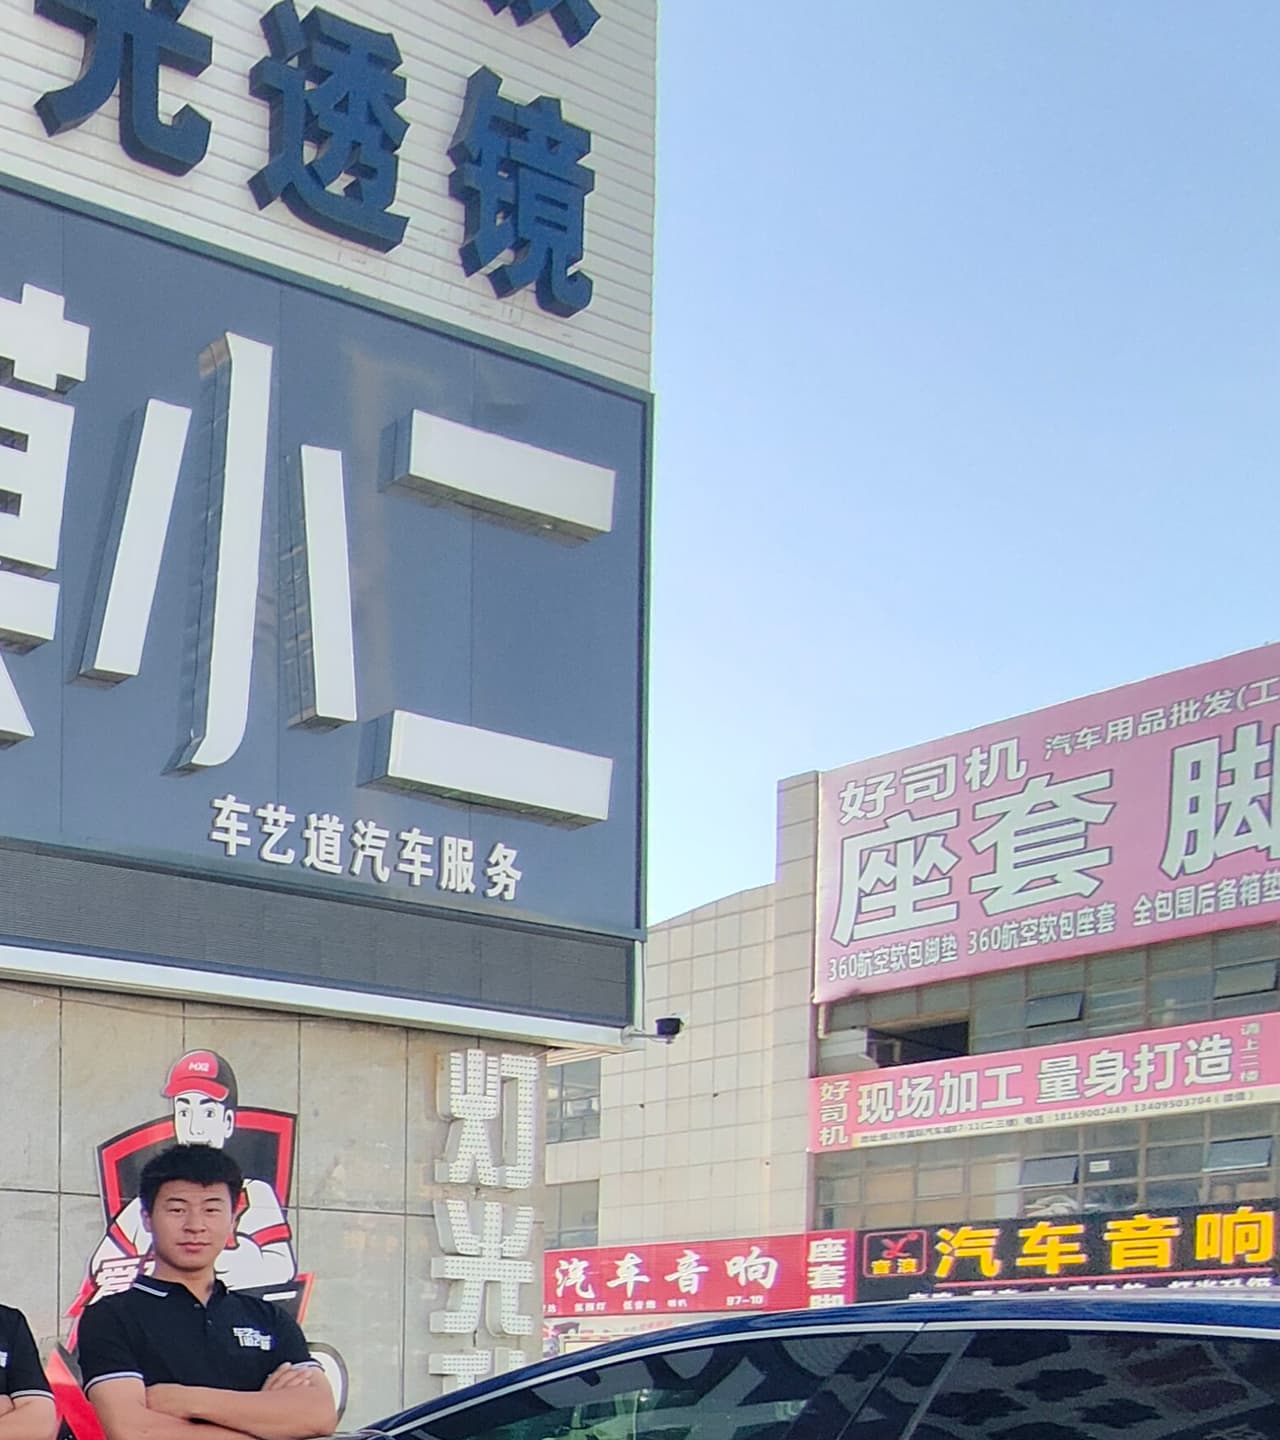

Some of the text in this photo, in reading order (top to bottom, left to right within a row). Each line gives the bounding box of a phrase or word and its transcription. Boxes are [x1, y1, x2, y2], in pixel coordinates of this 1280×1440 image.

[839, 736, 1029, 825] 好司机
[209, 794, 523, 901] 车艺道汽车服务
[831, 768, 1117, 949] 座套
[828, 934, 959, 983] 360航空软包脚垫
[967, 902, 1117, 955] 360航空软包座套
[819, 1081, 851, 1147] 好司机
[856, 1032, 1234, 1125] 现场加工 量身打造
[554, 1246, 779, 1300] 汽车音响
[933, 1205, 1276, 1279] 汽车音响
